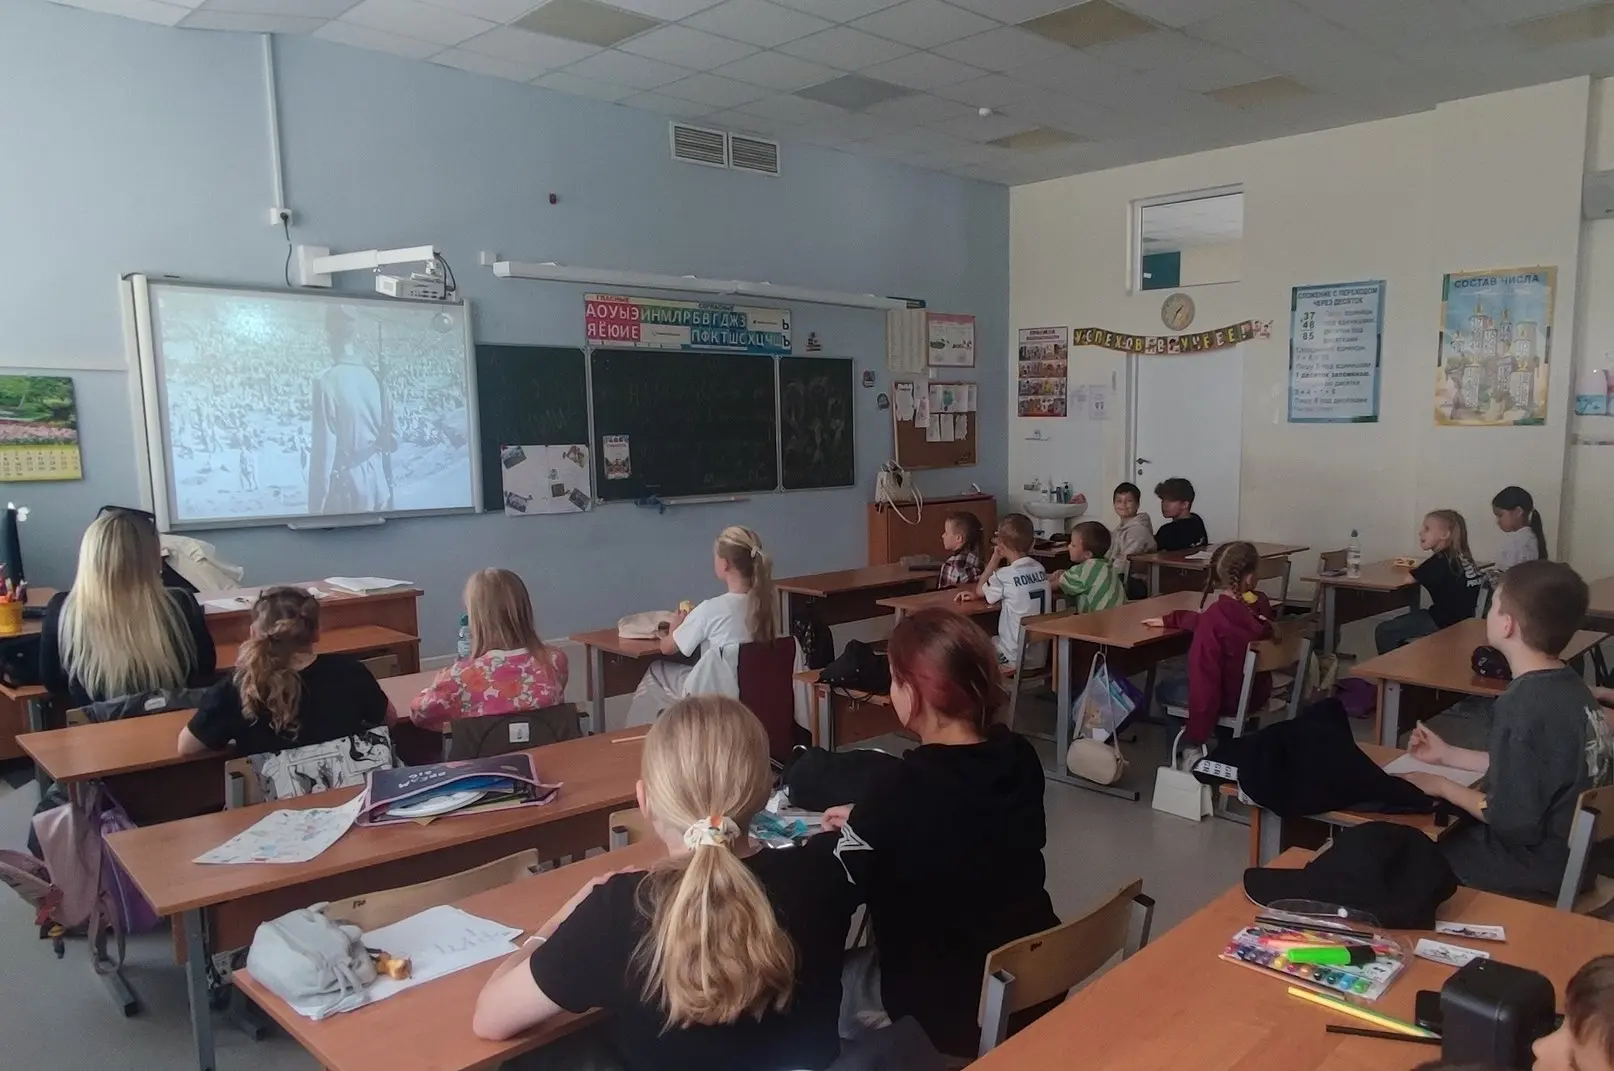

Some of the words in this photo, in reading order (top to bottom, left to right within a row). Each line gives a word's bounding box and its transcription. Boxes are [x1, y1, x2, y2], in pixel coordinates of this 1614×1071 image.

[1454, 277, 1497, 288] СОСТАВ
[1501, 274, 1540, 285] ЧИСЛА
[1303, 311, 1316, 320] 37
[1075, 329, 1142, 351] УСПЕХОВ
[1013, 571, 1046, 587] RONALD
[1029, 589, 1045, 614] 7
